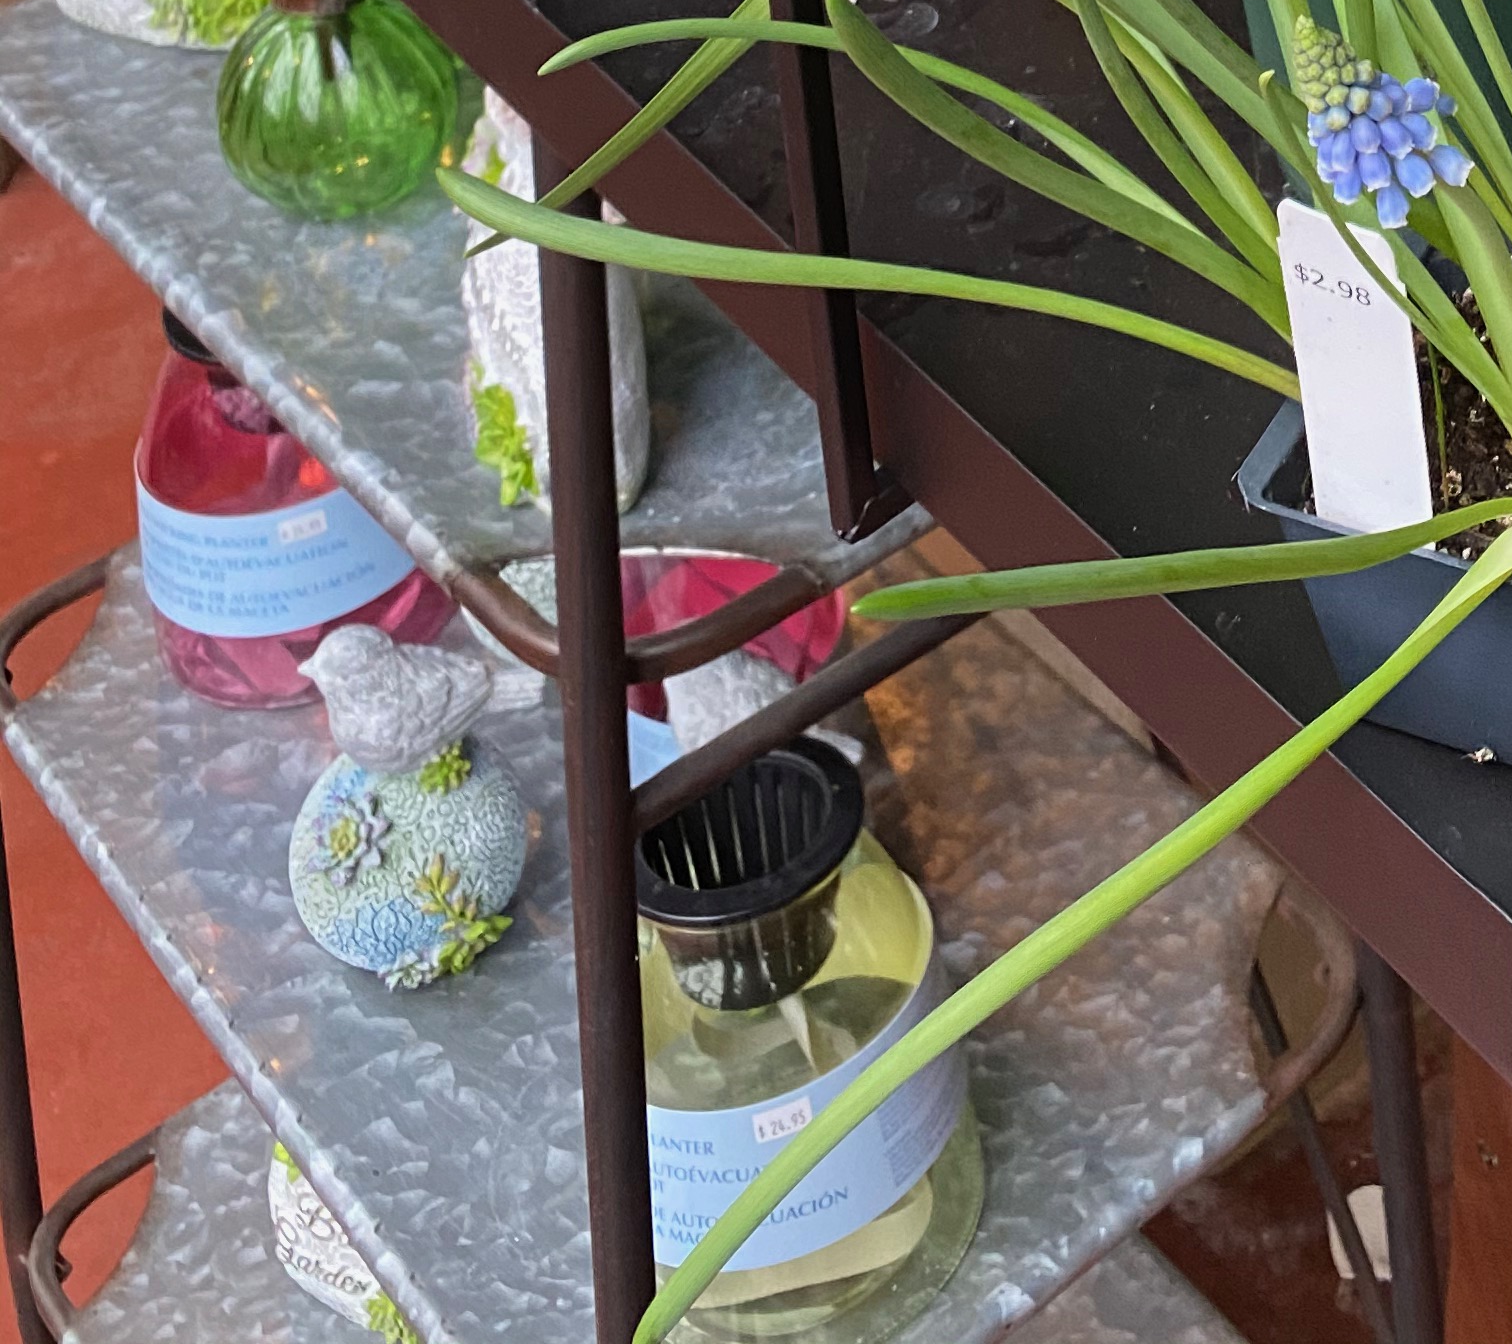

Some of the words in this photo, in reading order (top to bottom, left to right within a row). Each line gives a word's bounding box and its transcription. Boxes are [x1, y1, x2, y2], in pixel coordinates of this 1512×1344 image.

[1294, 263, 1371, 306] $2.98
[651, 1133, 716, 1155] LANTER
[653, 1161, 762, 1184] UTOÉVACUA
